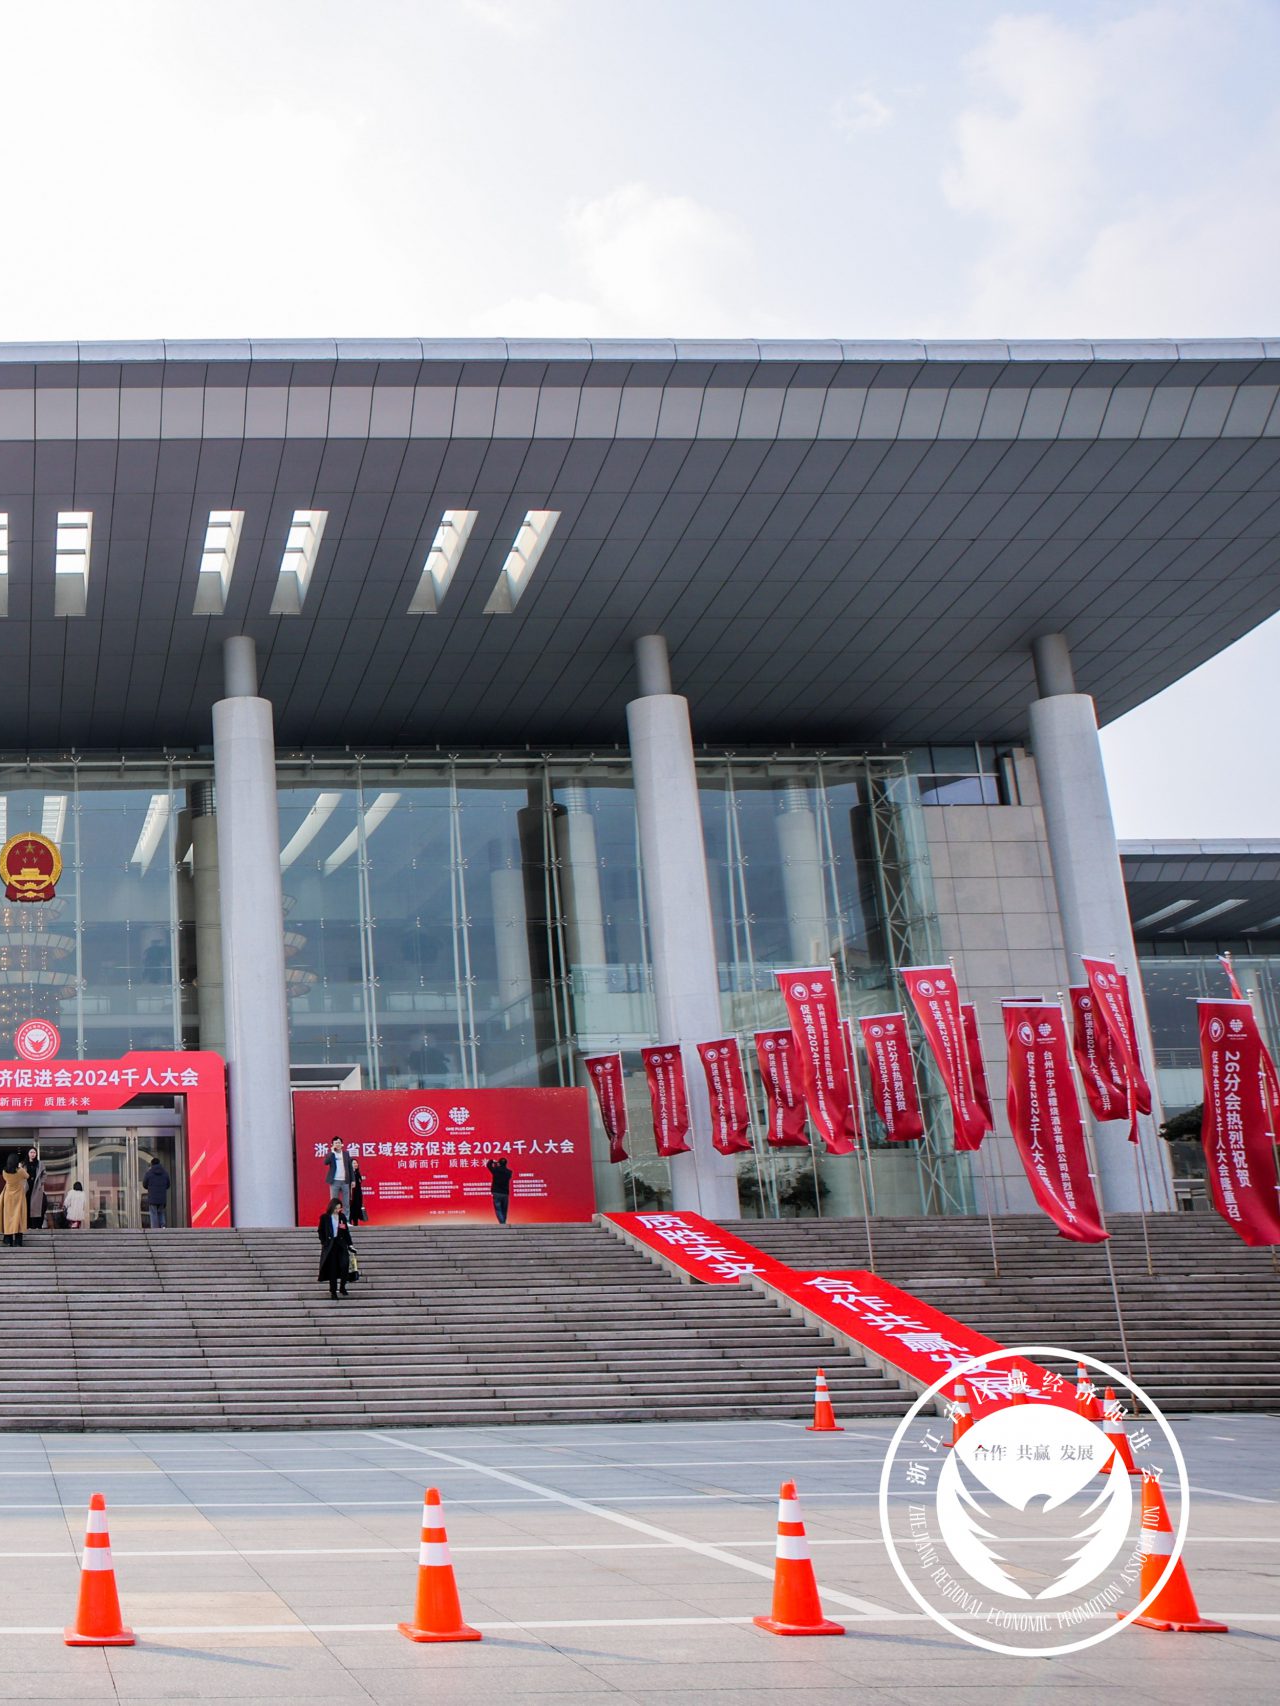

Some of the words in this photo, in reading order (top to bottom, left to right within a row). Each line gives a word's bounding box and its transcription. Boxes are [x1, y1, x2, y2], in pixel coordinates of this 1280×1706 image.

[44, 1096, 91, 1107] 质胜未来
[886, 1040, 907, 1111] 52分会热烈祝贺
[314, 1139, 575, 1157] 浙省区域经济促进会2024千人大会
[1211, 1051, 1242, 1221] 促进会2024千人大会隆重召
[1224, 1051, 1252, 1188] 26分会热烈祝贺
[397, 1159, 439, 1169] 向新而行
[634, 1214, 766, 1279] 质胜未来
